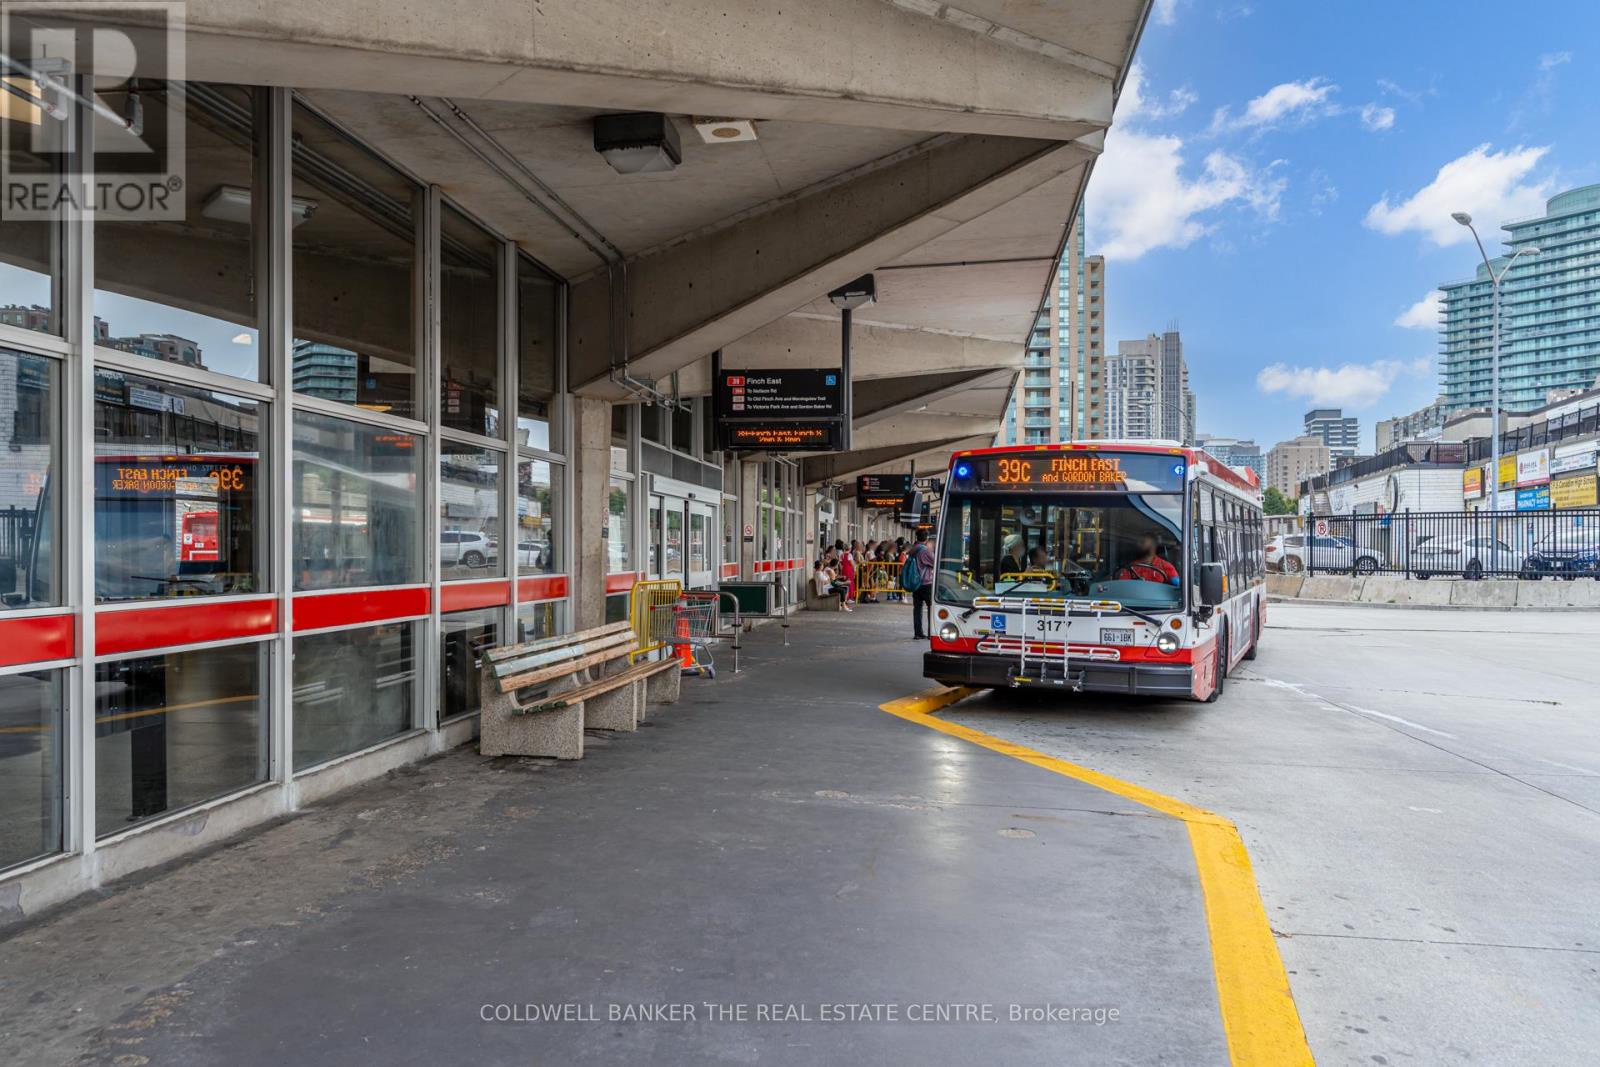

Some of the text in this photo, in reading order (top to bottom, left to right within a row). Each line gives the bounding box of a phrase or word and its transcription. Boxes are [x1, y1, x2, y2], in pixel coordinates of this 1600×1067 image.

[1052, 459, 1088, 471] FINCH
[1091, 459, 1121, 471] EAST
[1062, 471, 1096, 482] GORDON
[1099, 471, 1127, 482] BAKER
[1037, 620, 1072, 632] 3177
